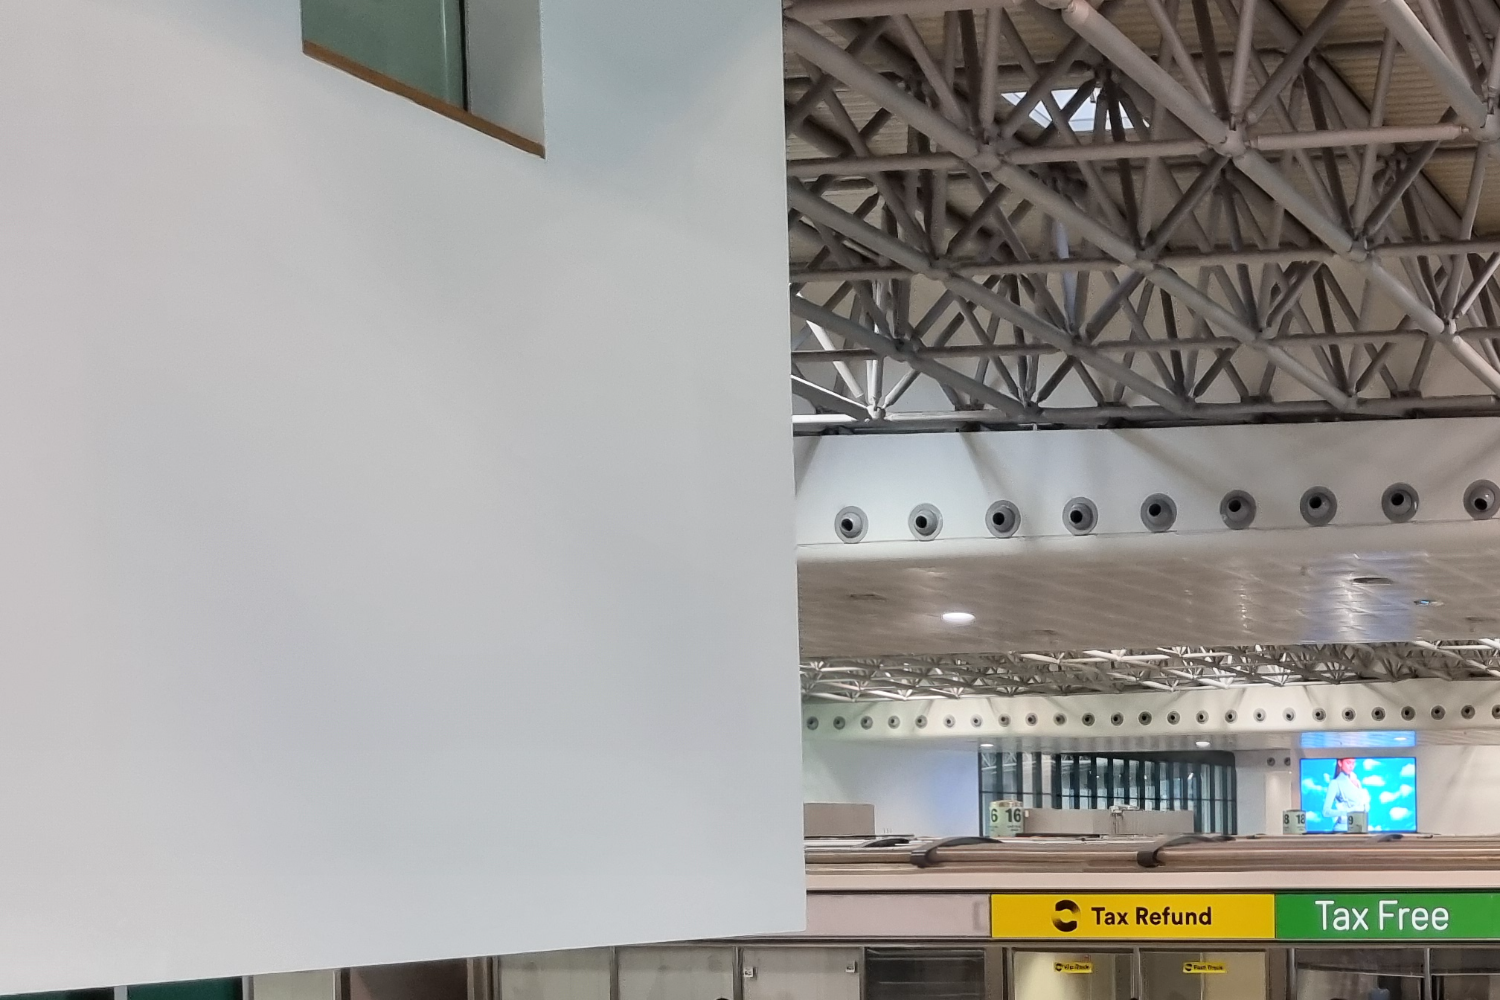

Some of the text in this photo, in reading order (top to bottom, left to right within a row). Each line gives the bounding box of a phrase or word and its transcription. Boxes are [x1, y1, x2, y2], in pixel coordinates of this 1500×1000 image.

[1005, 808, 1021, 823] 16
[1296, 814, 1305, 824] 18
[1091, 906, 1212, 926] Tax Refund
[1314, 899, 1449, 931] Tax Free
